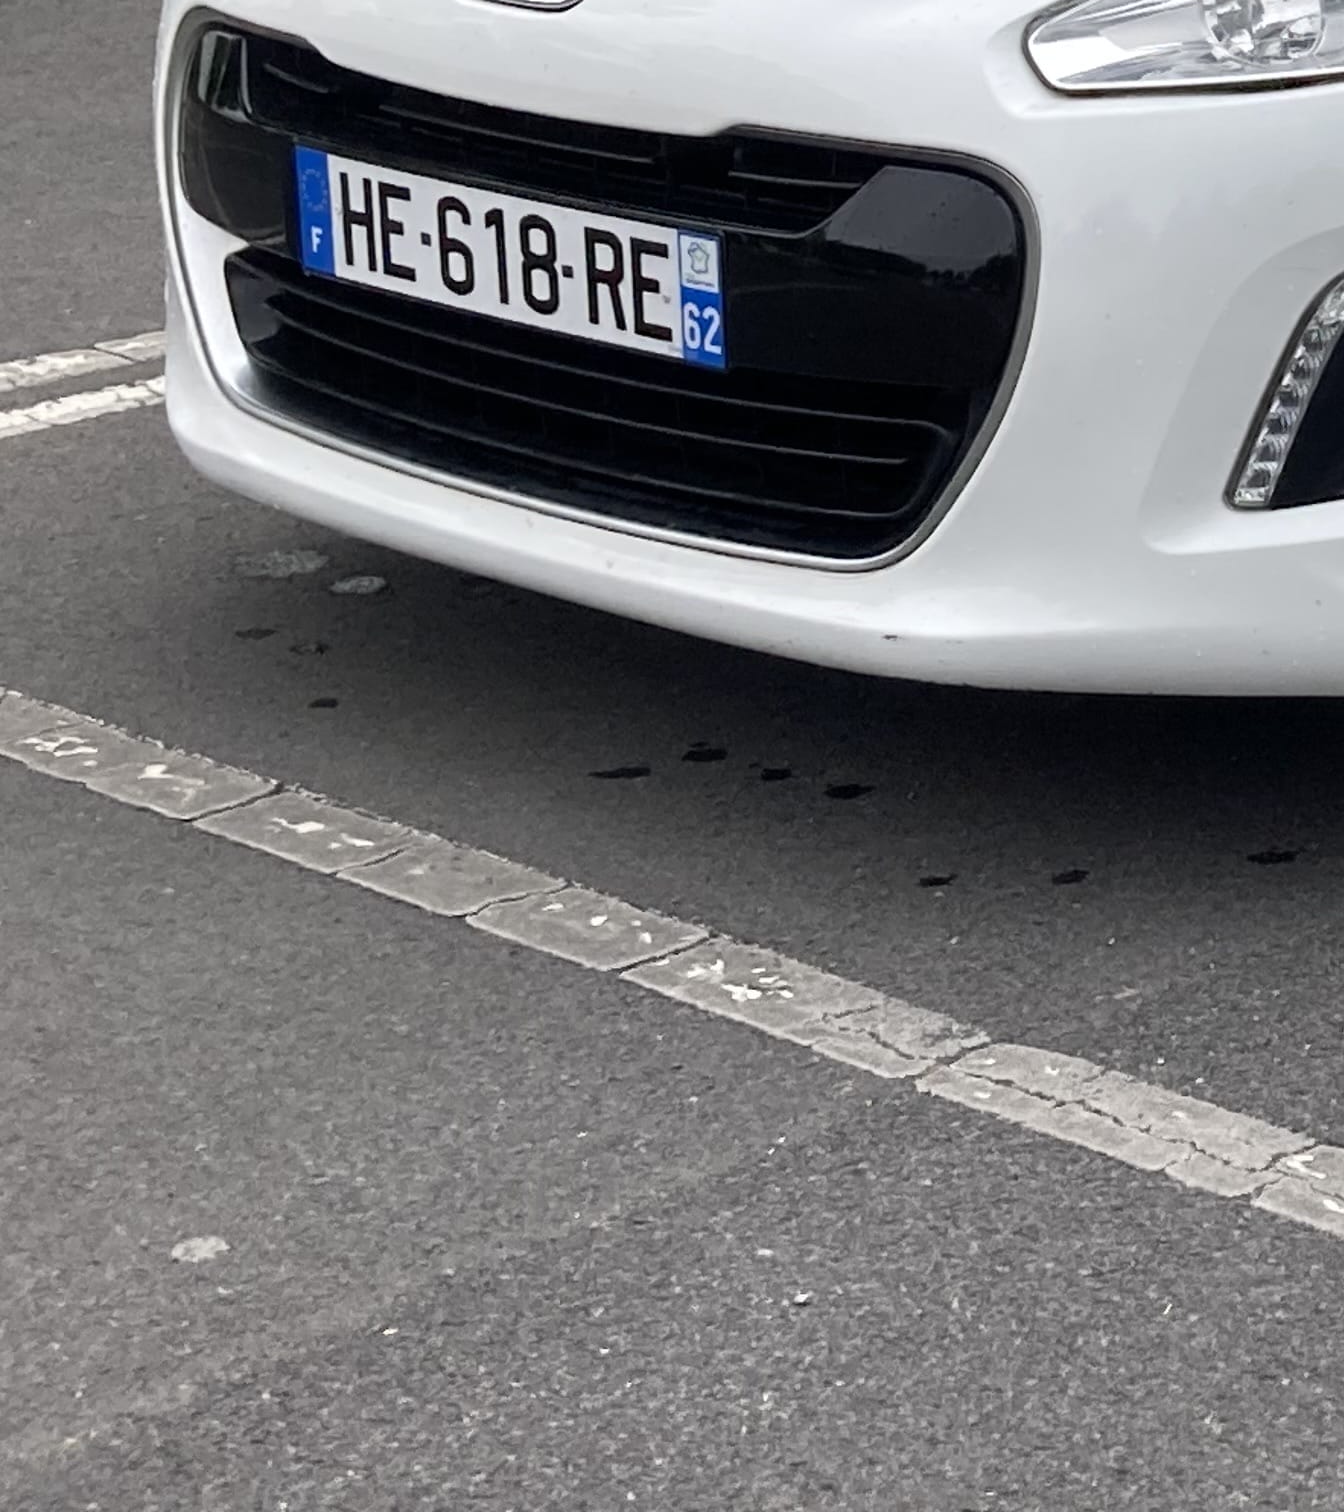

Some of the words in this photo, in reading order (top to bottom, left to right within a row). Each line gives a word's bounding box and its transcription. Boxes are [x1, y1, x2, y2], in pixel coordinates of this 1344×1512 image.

[309, 225, 323, 254] F
[338, 170, 673, 343] HE-618-RE
[683, 301, 722, 356] 62
